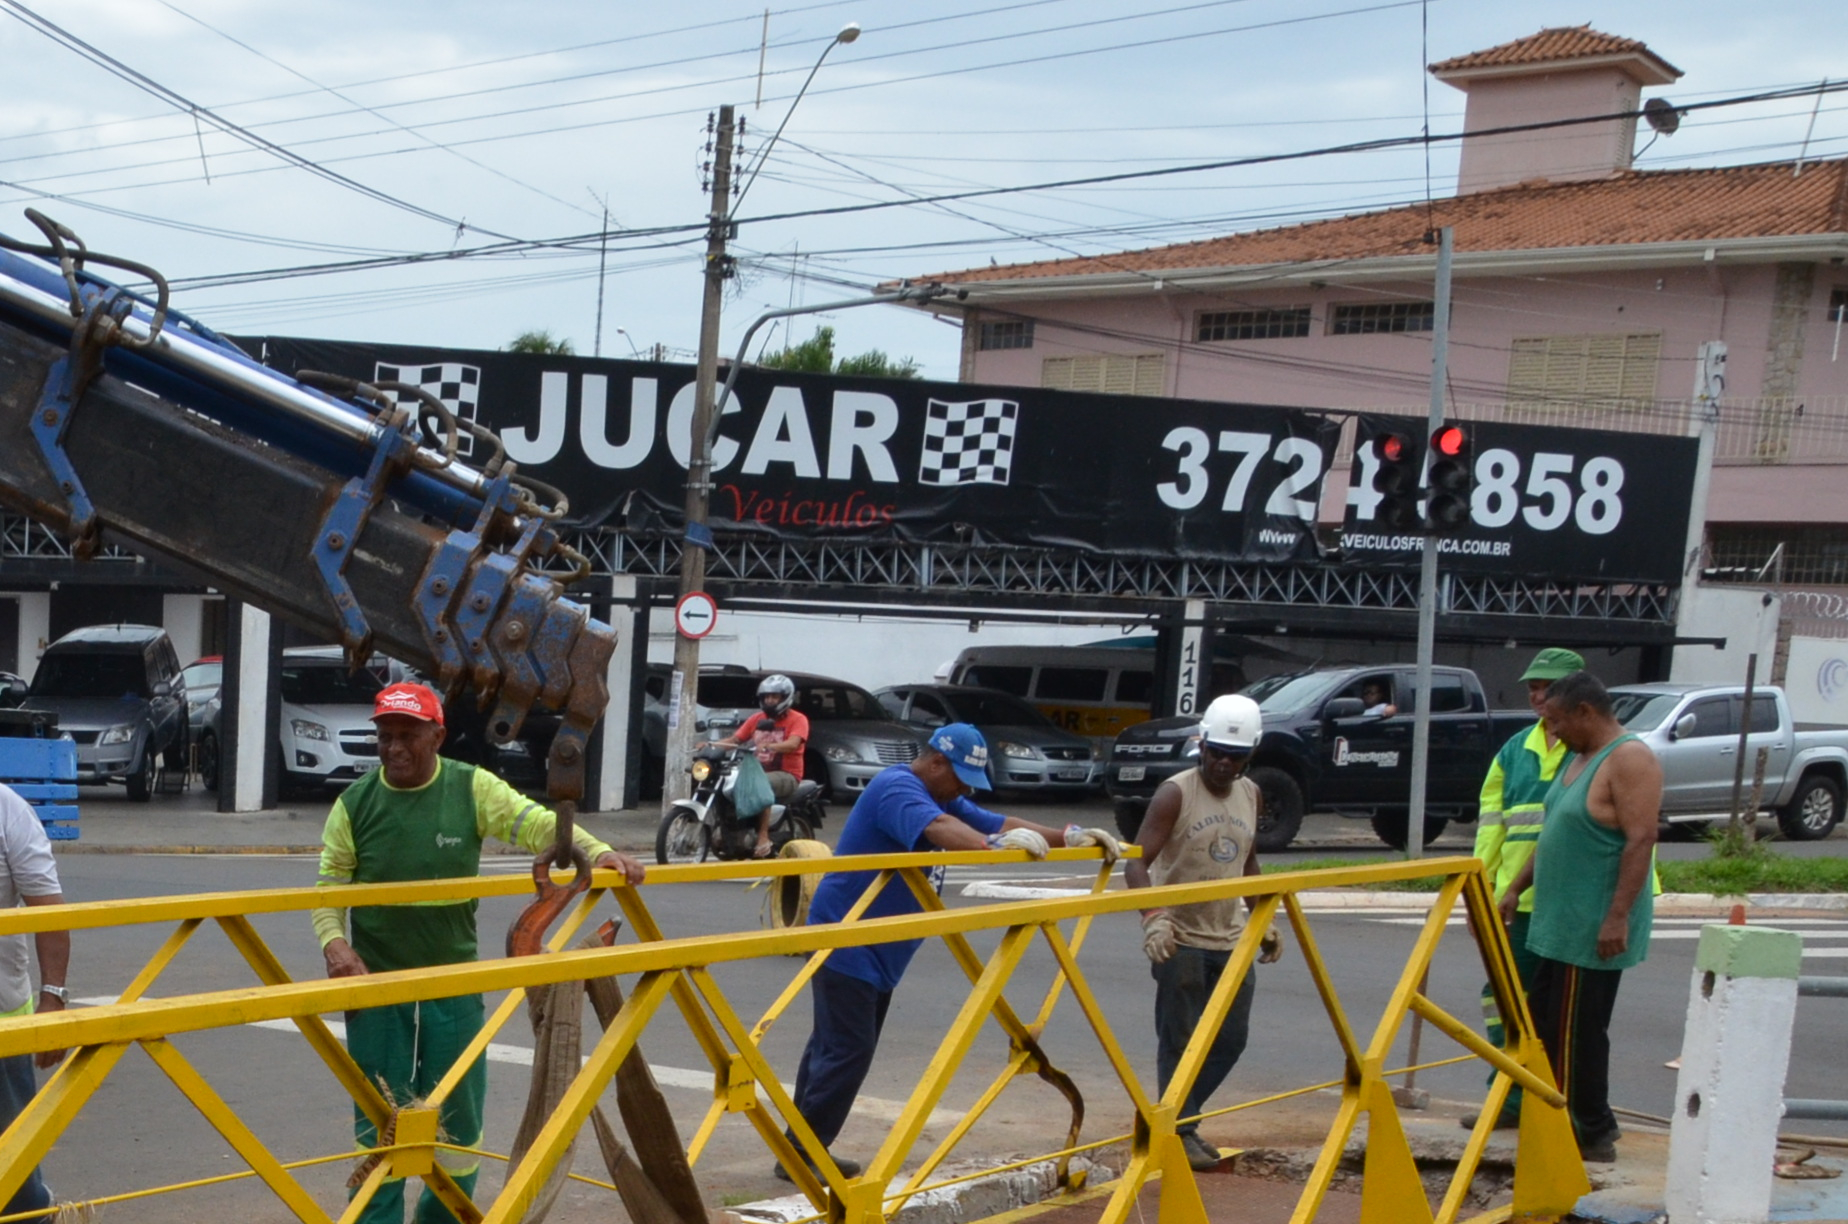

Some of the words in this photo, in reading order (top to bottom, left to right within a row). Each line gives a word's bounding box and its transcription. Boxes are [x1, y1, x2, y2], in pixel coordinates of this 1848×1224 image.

[499, 371, 900, 483] JUCAR
[1178, 640, 1197, 714] 116
[1114, 744, 1173, 753] FORD
